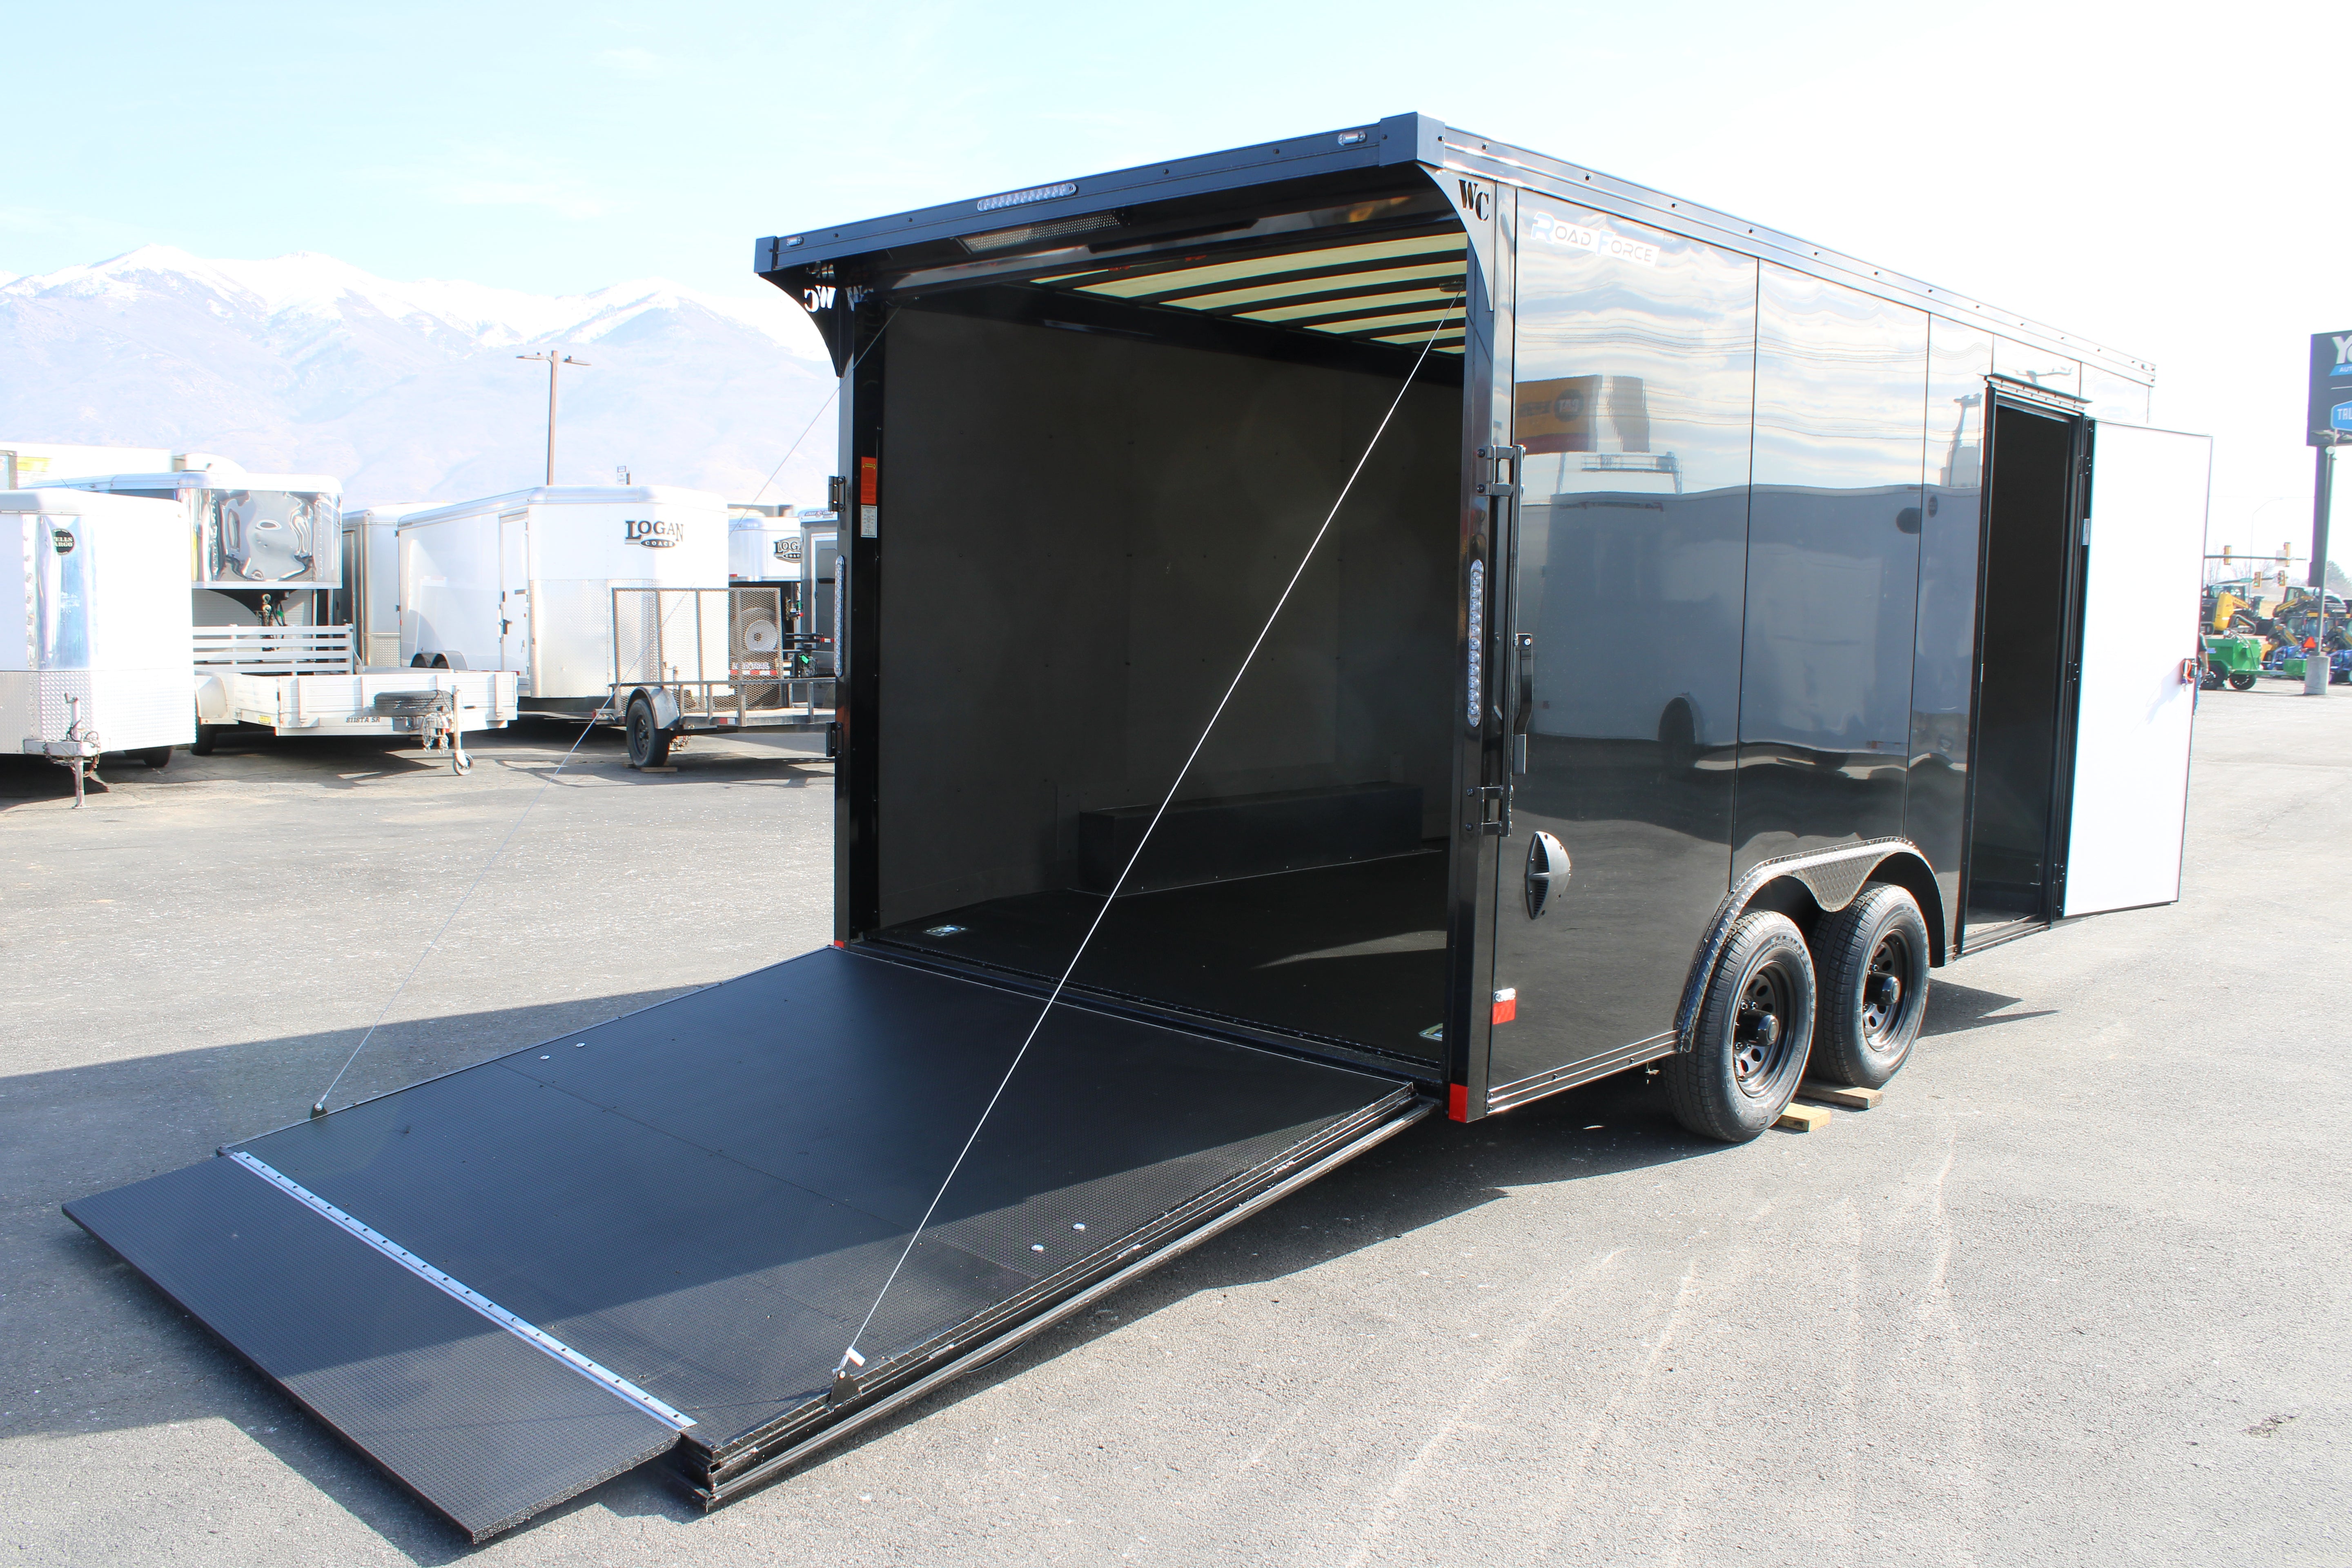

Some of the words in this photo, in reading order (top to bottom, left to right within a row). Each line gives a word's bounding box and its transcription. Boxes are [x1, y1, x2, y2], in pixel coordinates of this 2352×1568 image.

[1458, 179, 1489, 222] WC
[1530, 212, 1591, 246] ROAD
[1596, 230, 1653, 262] FORCE
[2332, 334, 2352, 364] Y
[625, 520, 684, 542] LOGAN
[774, 541, 801, 554] LOG
